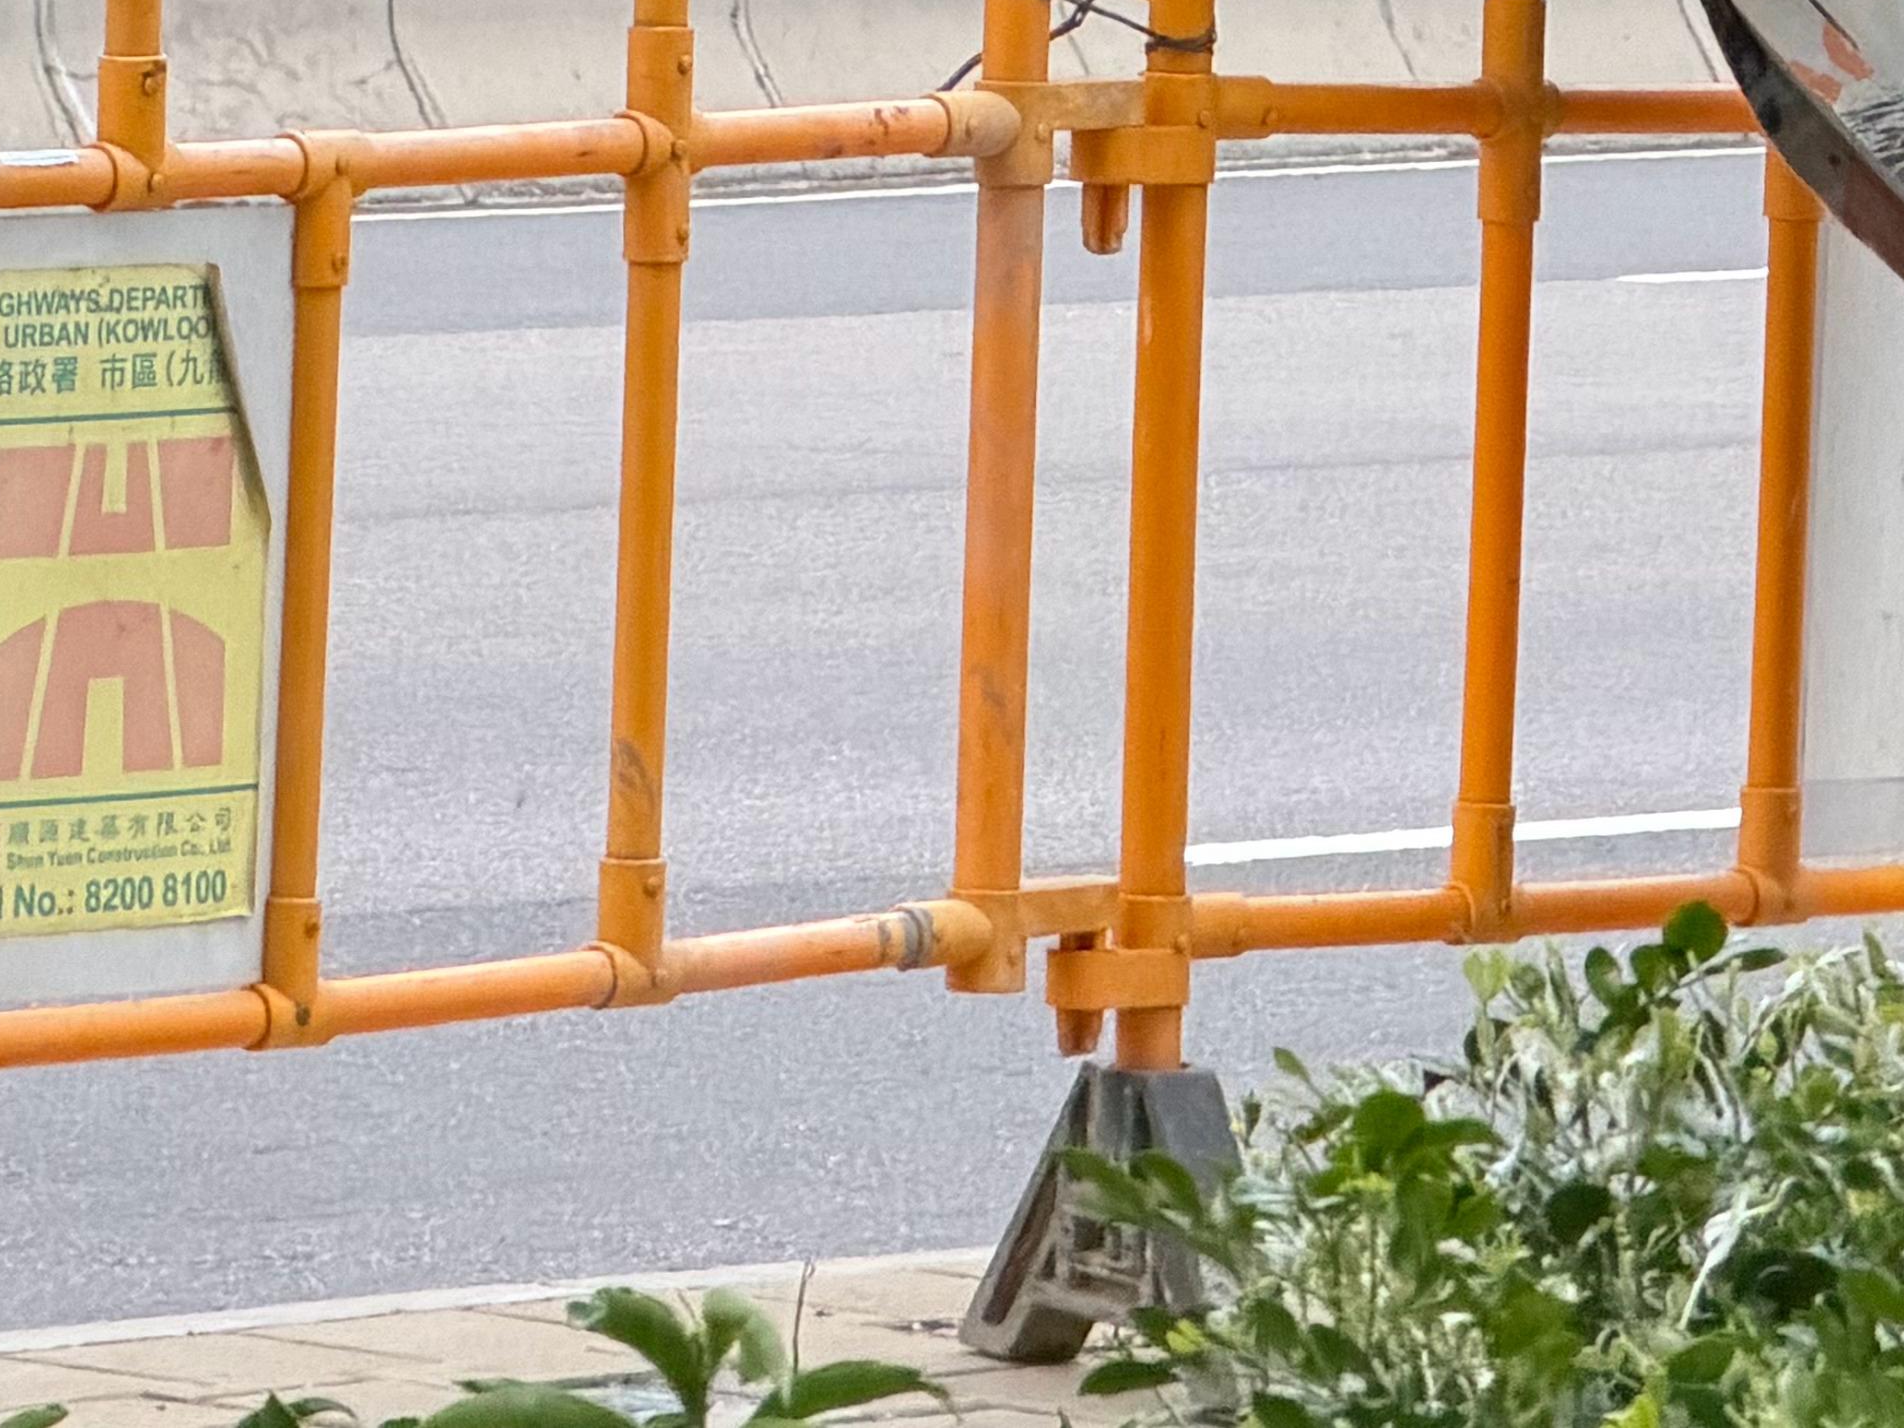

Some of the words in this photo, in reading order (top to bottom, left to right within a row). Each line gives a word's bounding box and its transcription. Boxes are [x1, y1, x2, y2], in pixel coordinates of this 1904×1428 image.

[3, 321, 90, 349] URBAN
[97, 315, 217, 348] (KOWLOO
[86, 845, 179, 865] Construction
[83, 875, 154, 914] 8200
[162, 869, 228, 907] 8100
